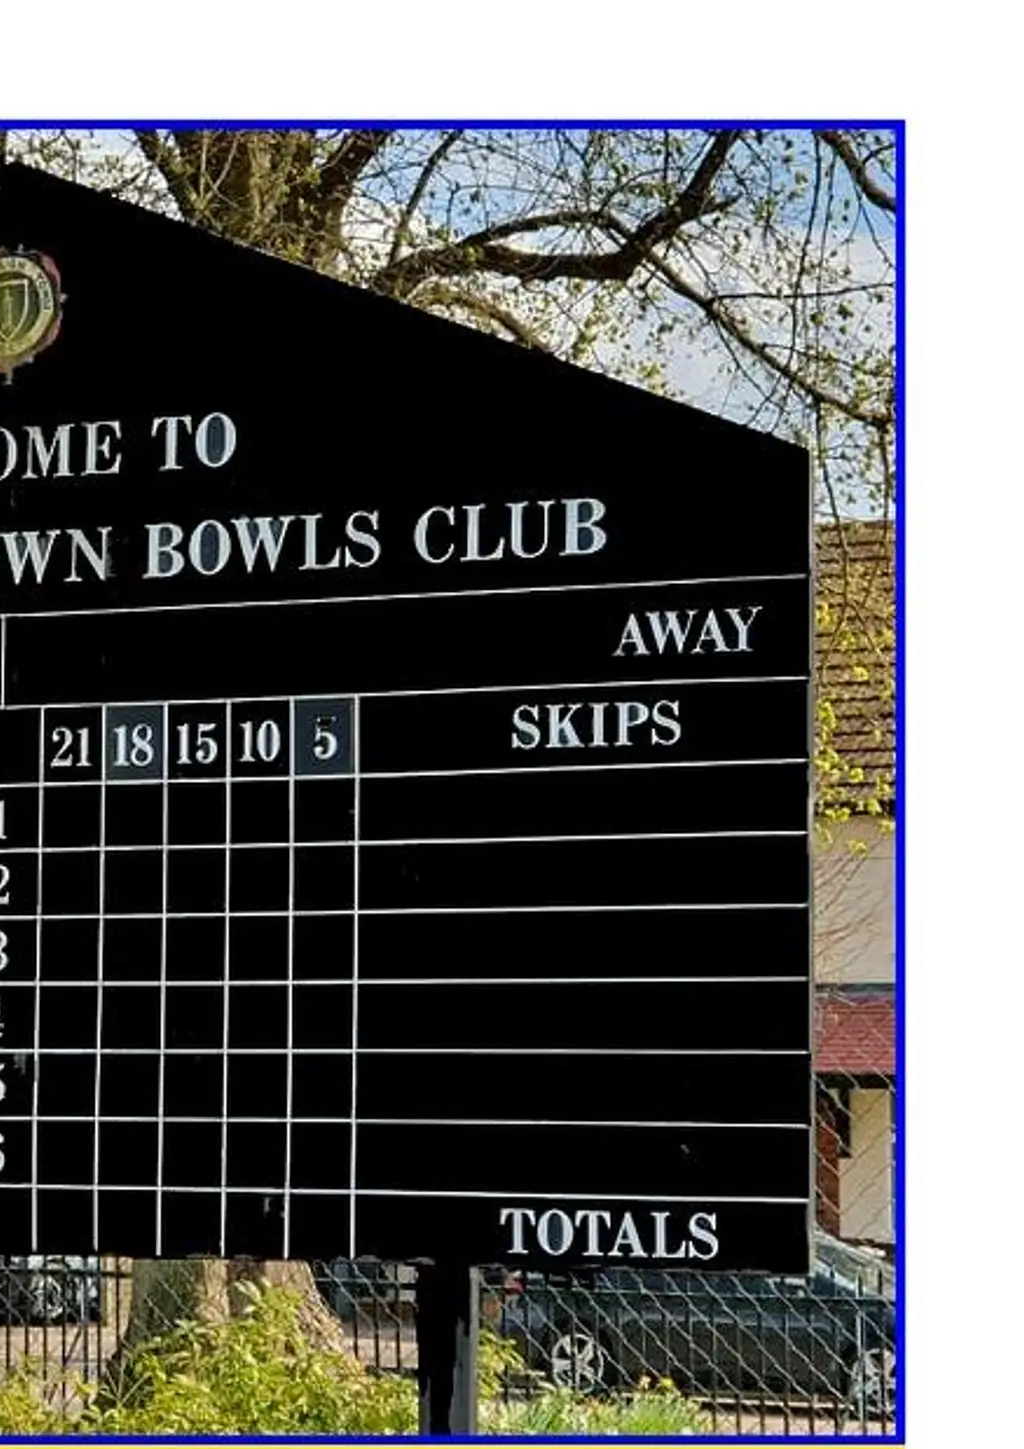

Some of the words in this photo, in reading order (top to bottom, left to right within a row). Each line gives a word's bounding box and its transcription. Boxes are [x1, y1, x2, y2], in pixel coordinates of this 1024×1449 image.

[151, 412, 237, 470] TO
[144, 511, 381, 579] BOWLS
[414, 499, 607, 564] CLUB
[615, 607, 762, 656] AWAY
[50, 728, 91, 767] 21
[113, 723, 154, 767] 18
[177, 723, 218, 764] 15
[240, 721, 281, 762] 10
[312, 720, 339, 760] 5
[511, 700, 681, 750] SKIPS
[501, 1209, 719, 1260] TOTALS
